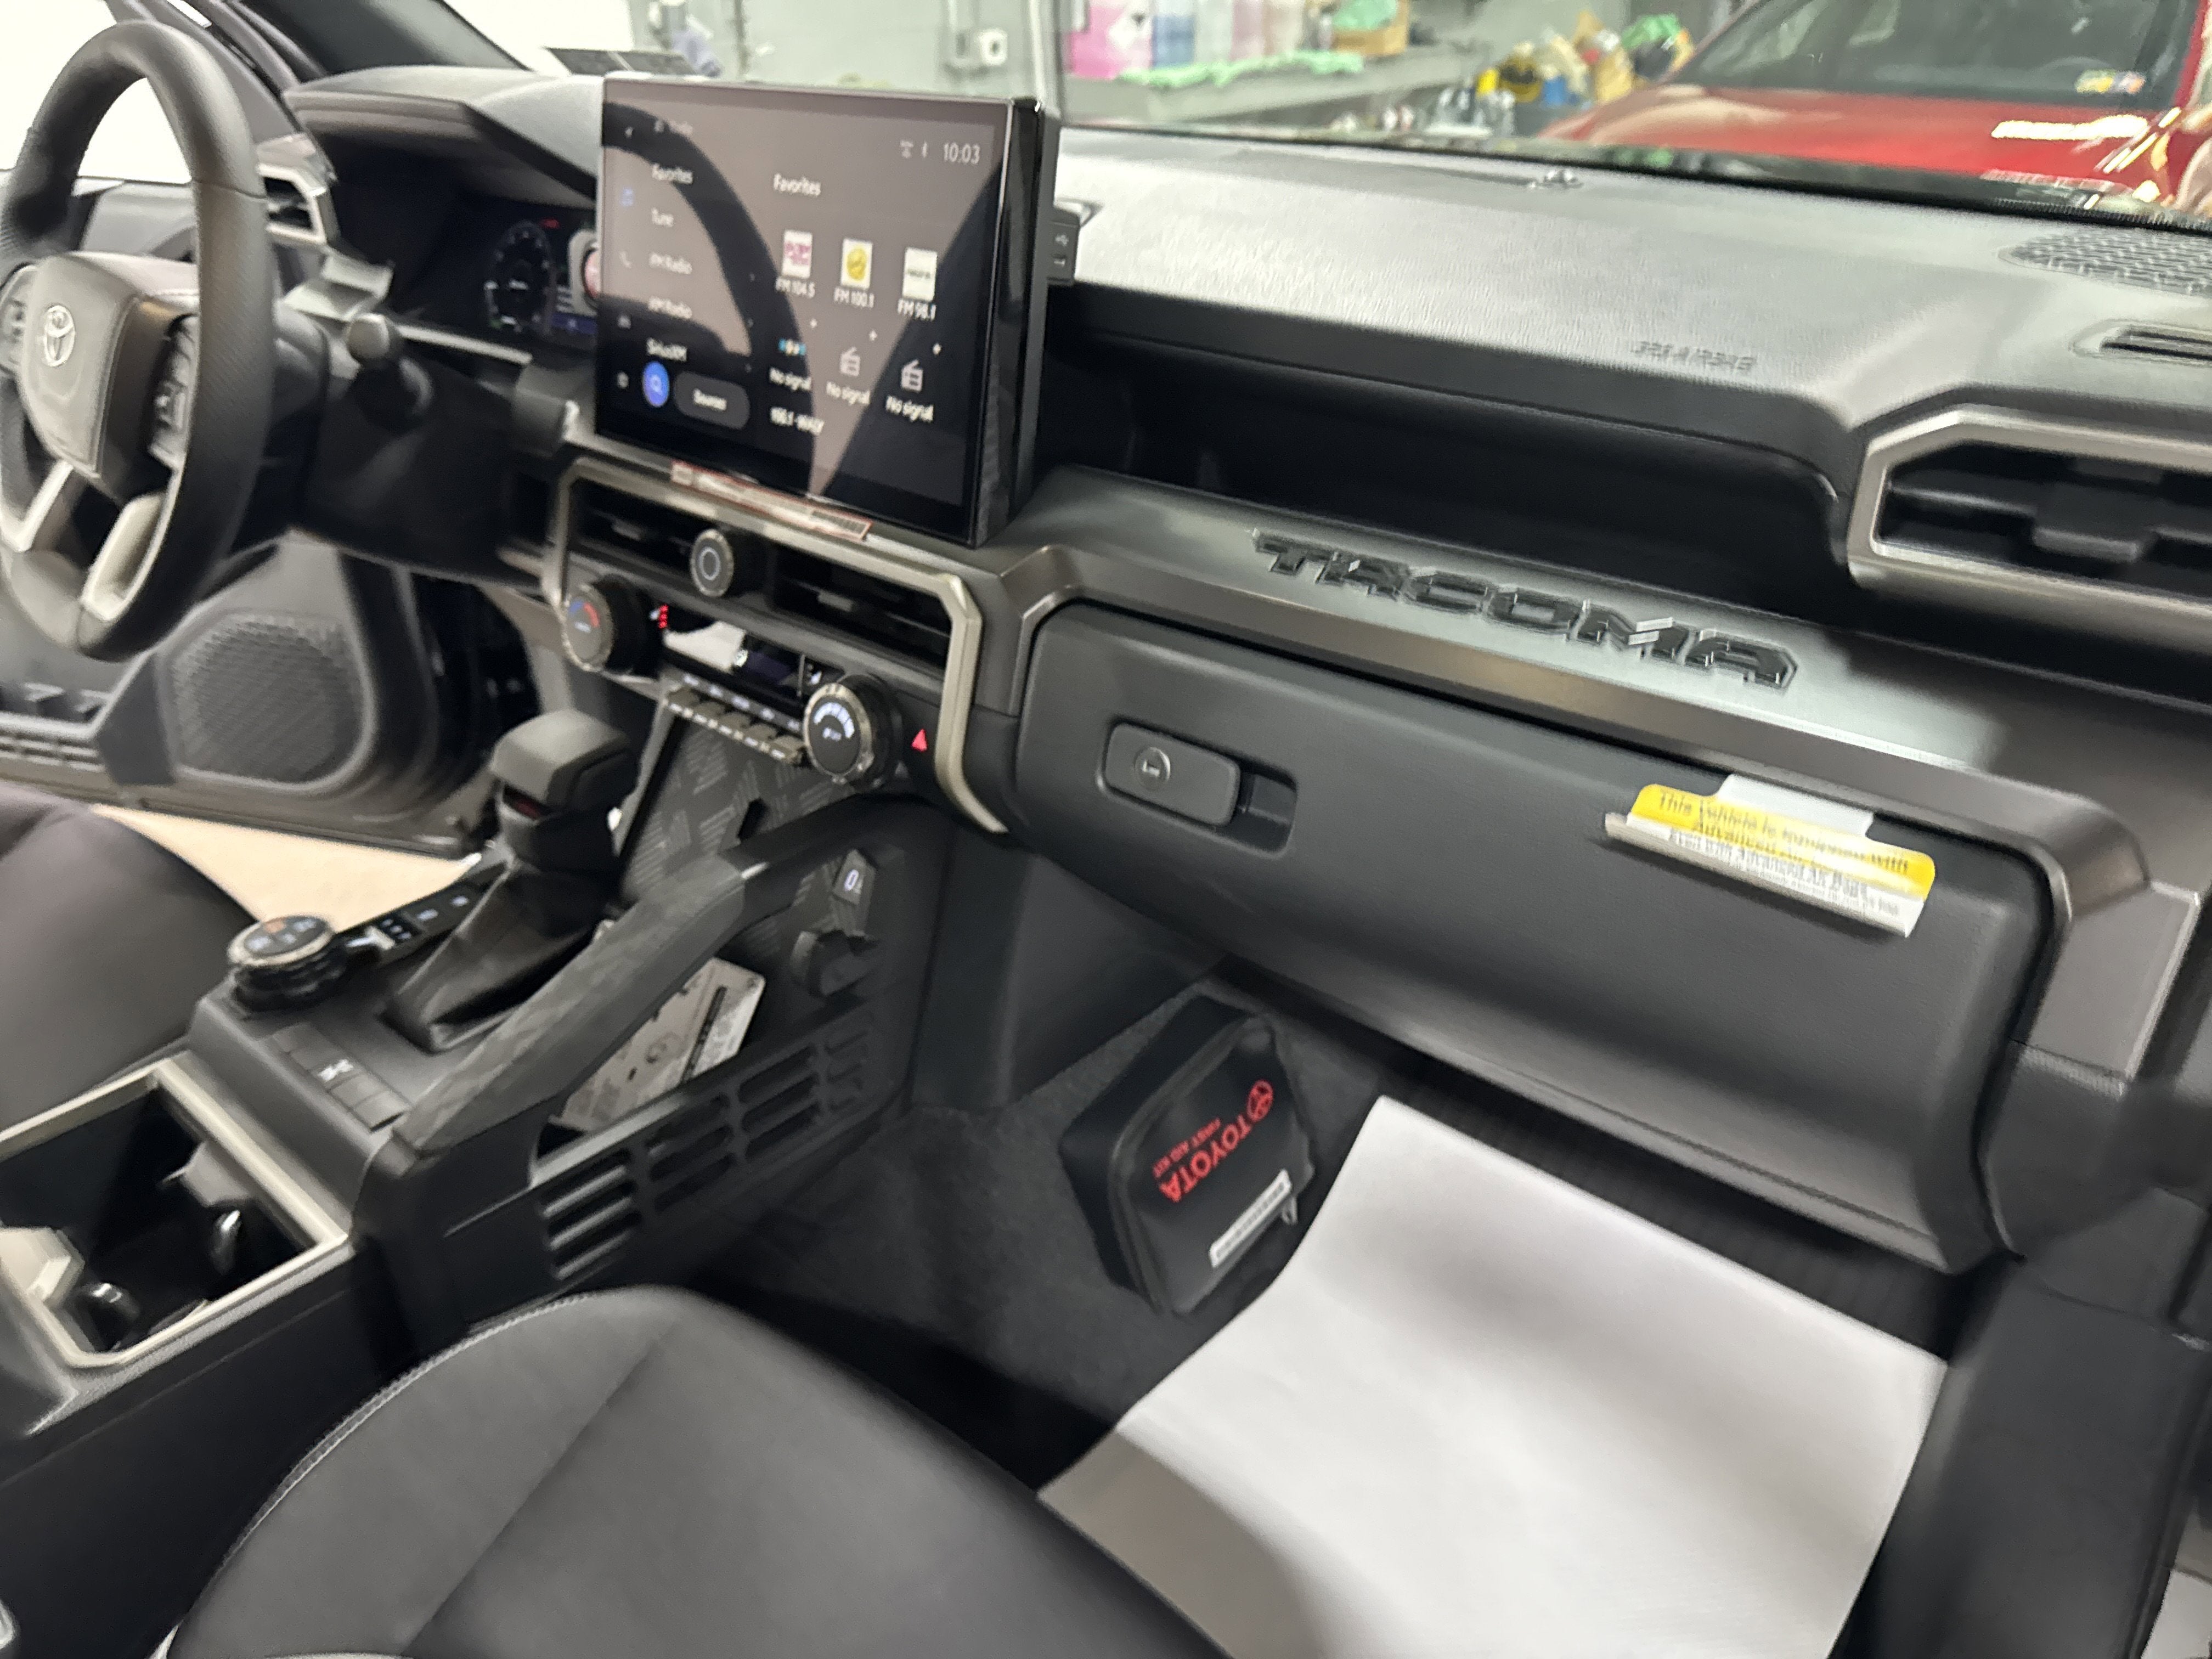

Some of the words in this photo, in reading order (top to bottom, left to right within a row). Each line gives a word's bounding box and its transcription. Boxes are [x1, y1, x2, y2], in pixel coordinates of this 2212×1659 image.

[943, 143, 981, 164] 10:03
[774, 173, 821, 196] Favorites
[833, 287, 850, 303] FM
[897, 298, 915, 316] FM
[769, 366, 786, 385] No
[826, 380, 842, 398] No
[885, 394, 903, 415] No
[902, 399, 934, 423] signal
[1252, 528, 1798, 691] TACOMA
[1660, 788, 1692, 816] This
[1158, 1113, 1254, 1203] TOYOTA
